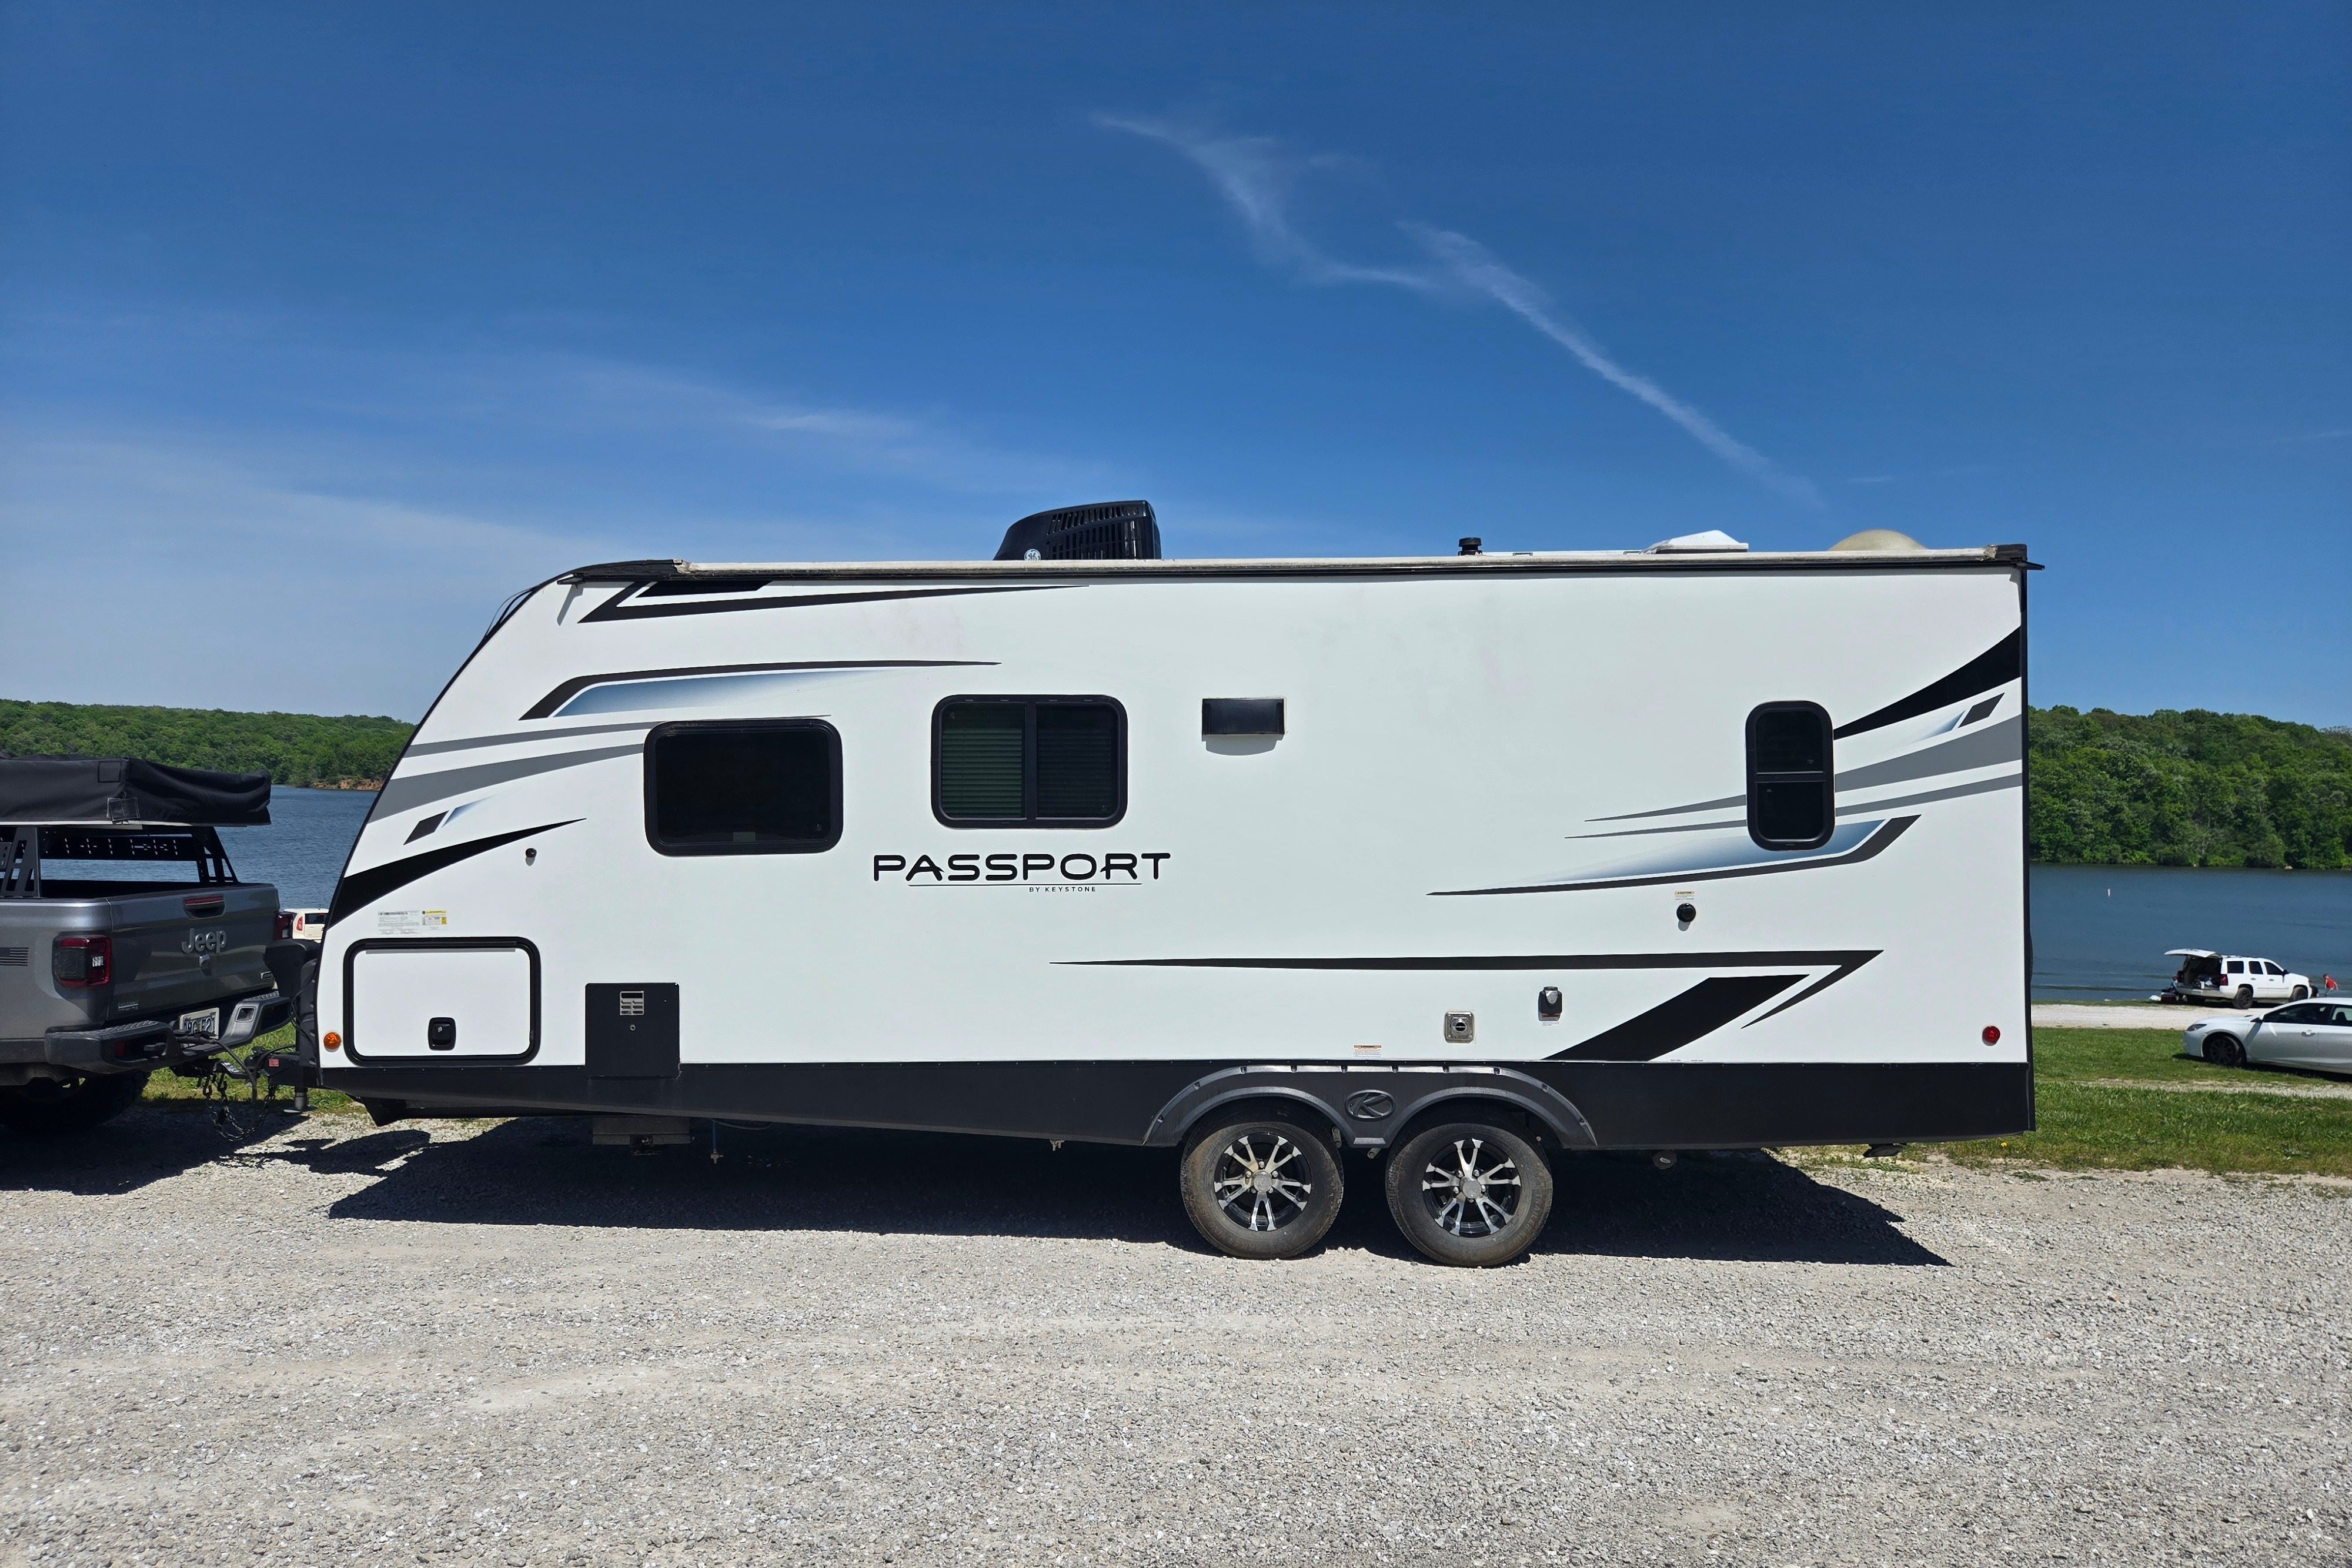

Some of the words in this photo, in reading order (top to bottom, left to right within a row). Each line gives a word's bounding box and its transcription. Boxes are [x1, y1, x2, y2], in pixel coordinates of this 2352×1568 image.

[874, 852, 1171, 882] PASSPORT
[181, 928, 226, 953] Jeep
[1524, 1194, 1543, 1230] TRAILER
